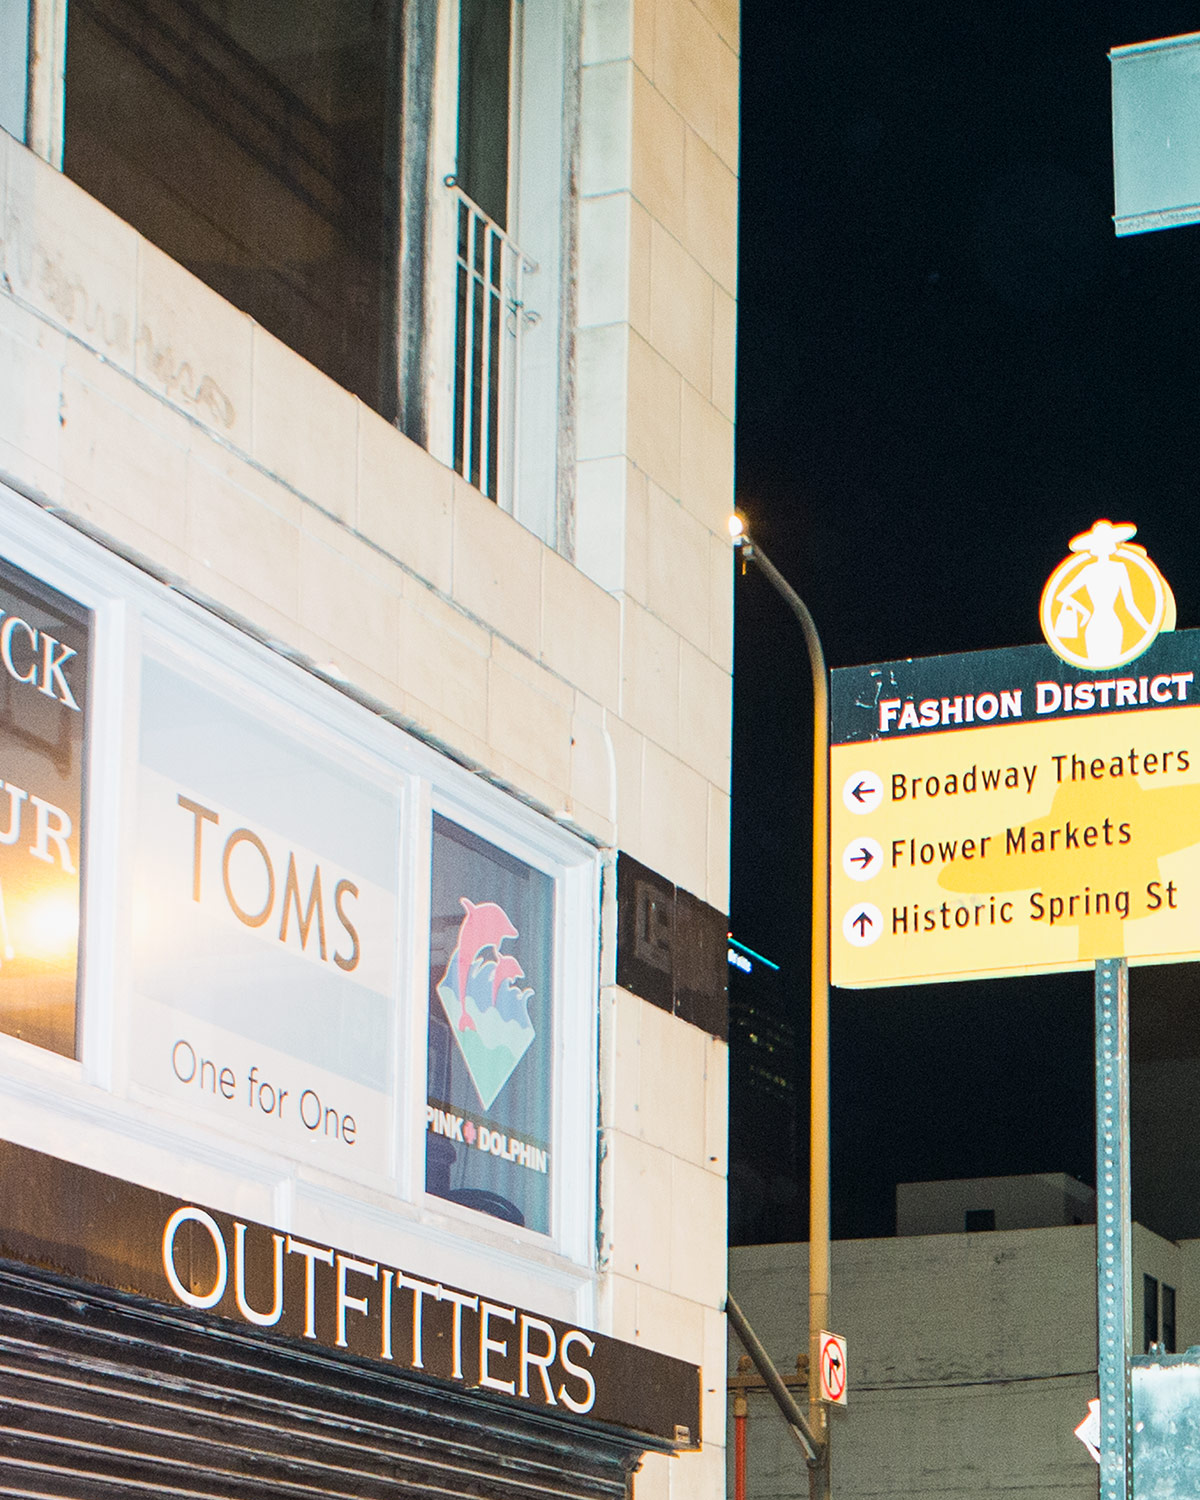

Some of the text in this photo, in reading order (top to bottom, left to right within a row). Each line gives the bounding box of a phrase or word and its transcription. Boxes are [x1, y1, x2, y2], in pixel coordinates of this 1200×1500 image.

[0, 608, 81, 712] CK
[879, 671, 1194, 733] FASHION DISTRICT
[891, 748, 1191, 802] Broadway Theaters
[891, 817, 1132, 868] Flower Markets
[177, 792, 361, 972] TOMS
[892, 880, 1178, 935] Historic Spring St
[172, 1039, 358, 1145] One for One
[425, 1104, 548, 1174] PINK DOLPHIN
[162, 1206, 597, 1415] OUTFITTERS
